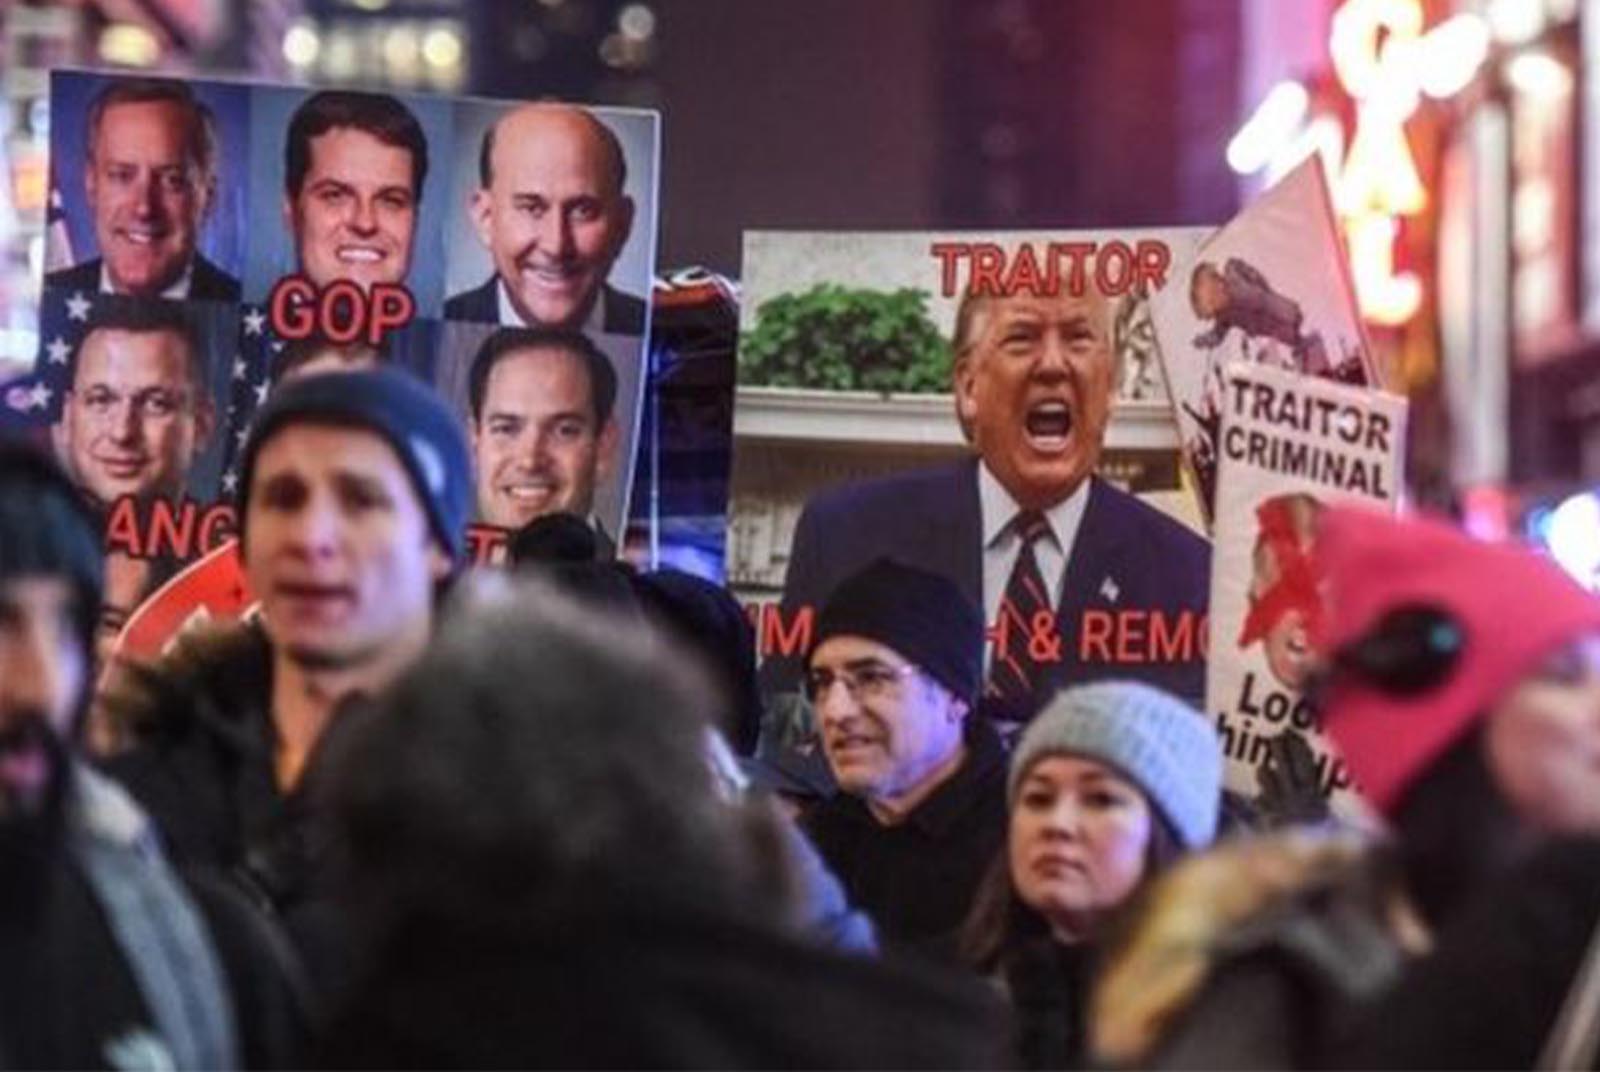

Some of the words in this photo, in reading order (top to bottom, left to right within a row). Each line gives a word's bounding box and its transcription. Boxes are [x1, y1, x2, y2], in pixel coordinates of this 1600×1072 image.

[931, 240, 1171, 298] TRAITOR
[270, 278, 415, 344] GOP
[1231, 378, 1390, 453] TRAITOR
[1225, 425, 1388, 500] CRIMINAL
